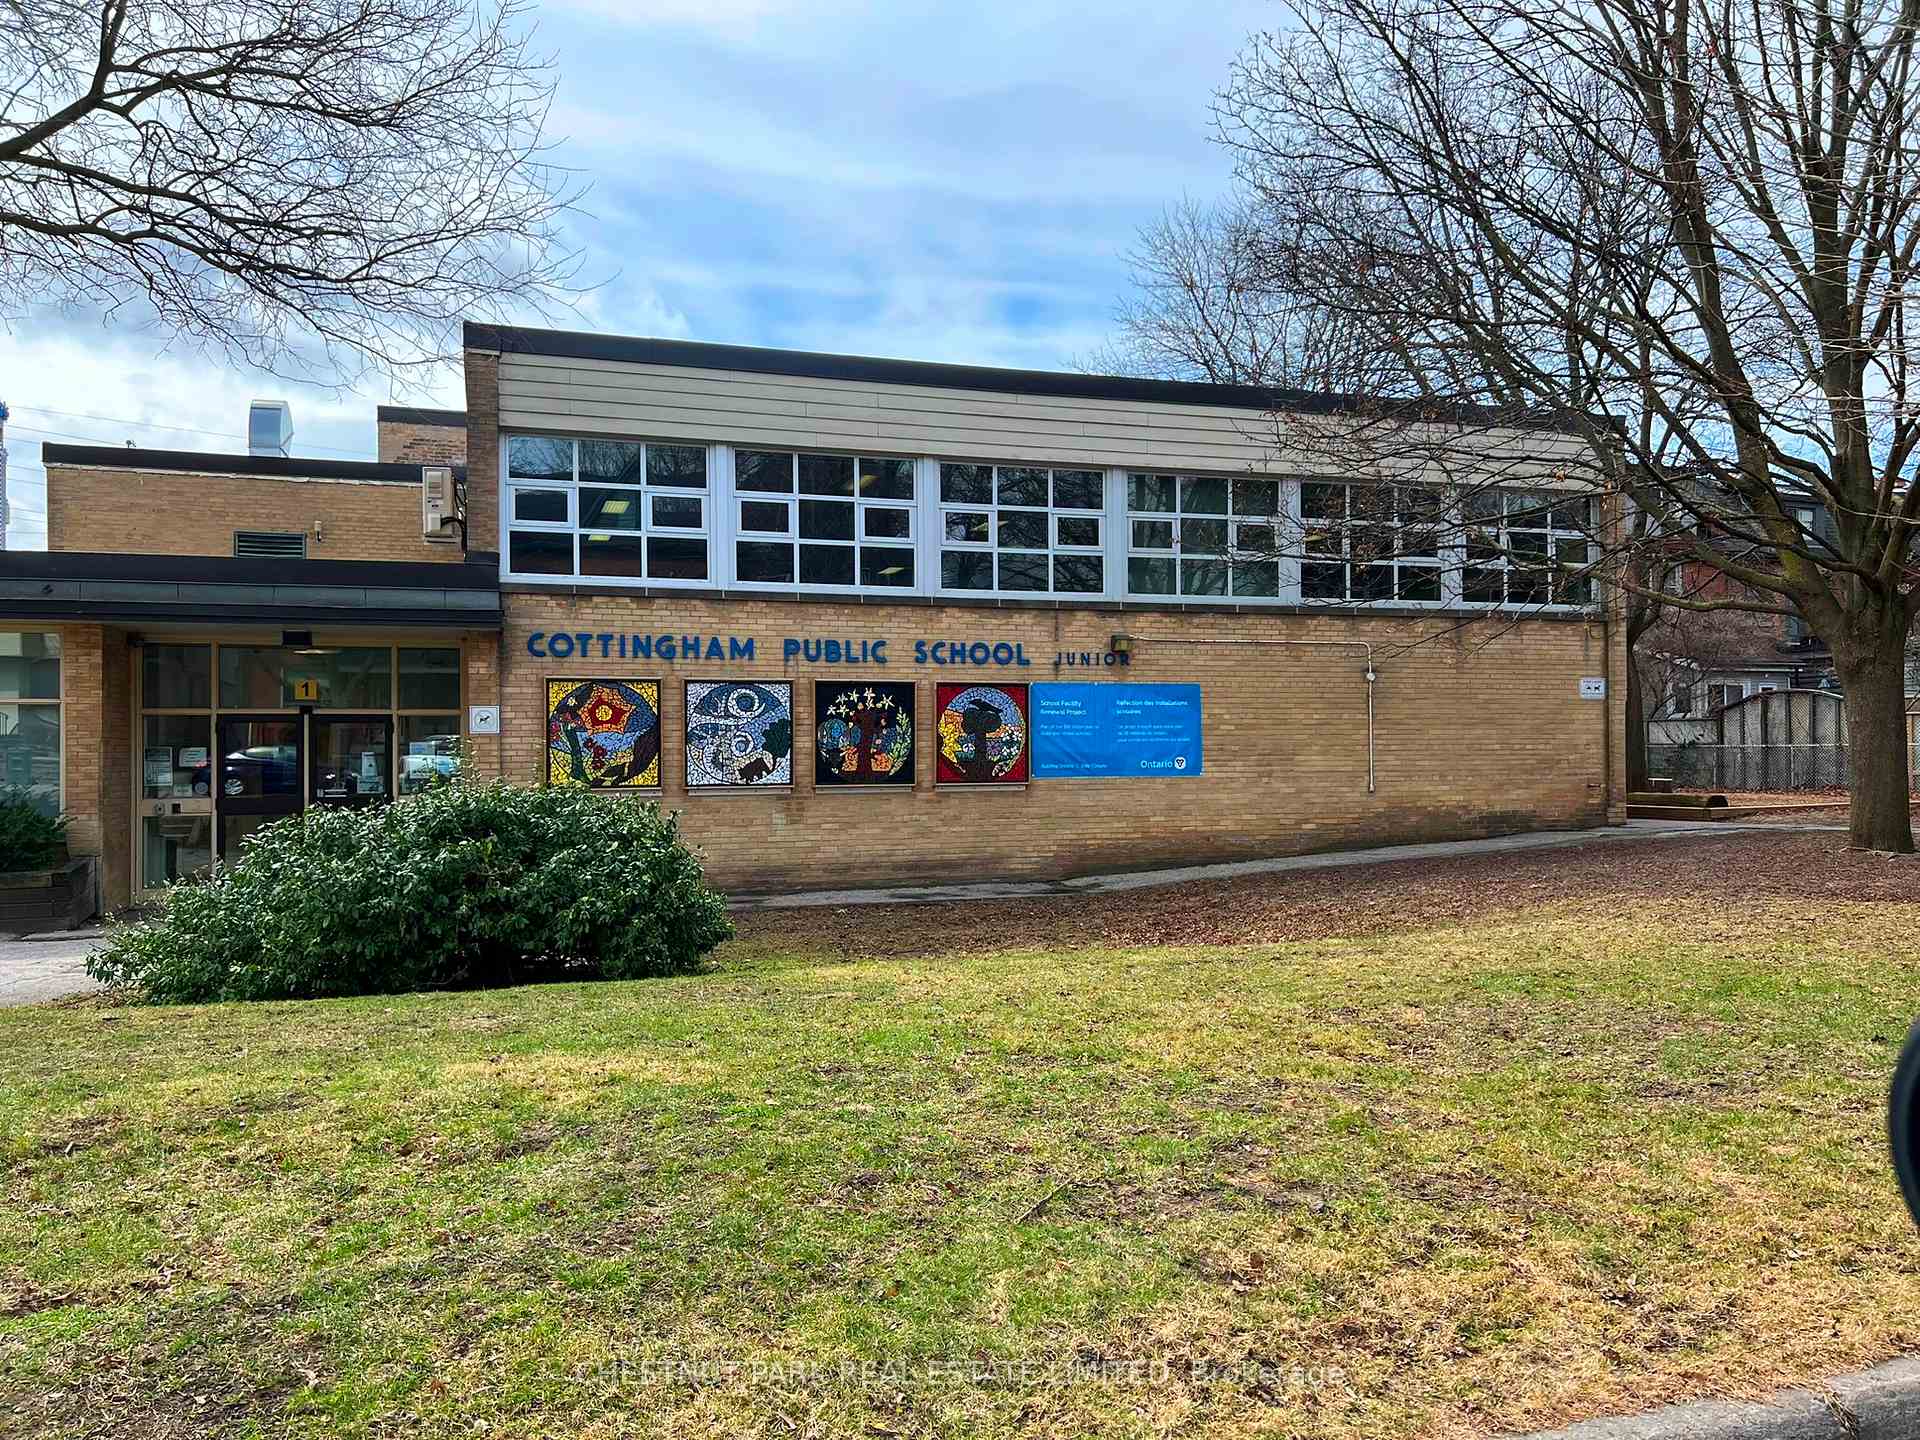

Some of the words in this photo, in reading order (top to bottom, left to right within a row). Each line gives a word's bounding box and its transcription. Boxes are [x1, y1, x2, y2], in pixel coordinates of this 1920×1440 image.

[527, 632, 754, 661] COTTINGHAM
[783, 638, 887, 664] PUBLIC
[914, 640, 1031, 666] SCHOOL
[1054, 652, 1130, 667] JUNIOR
[301, 682, 308, 697] 1
[1140, 759, 1173, 769] Ontario
